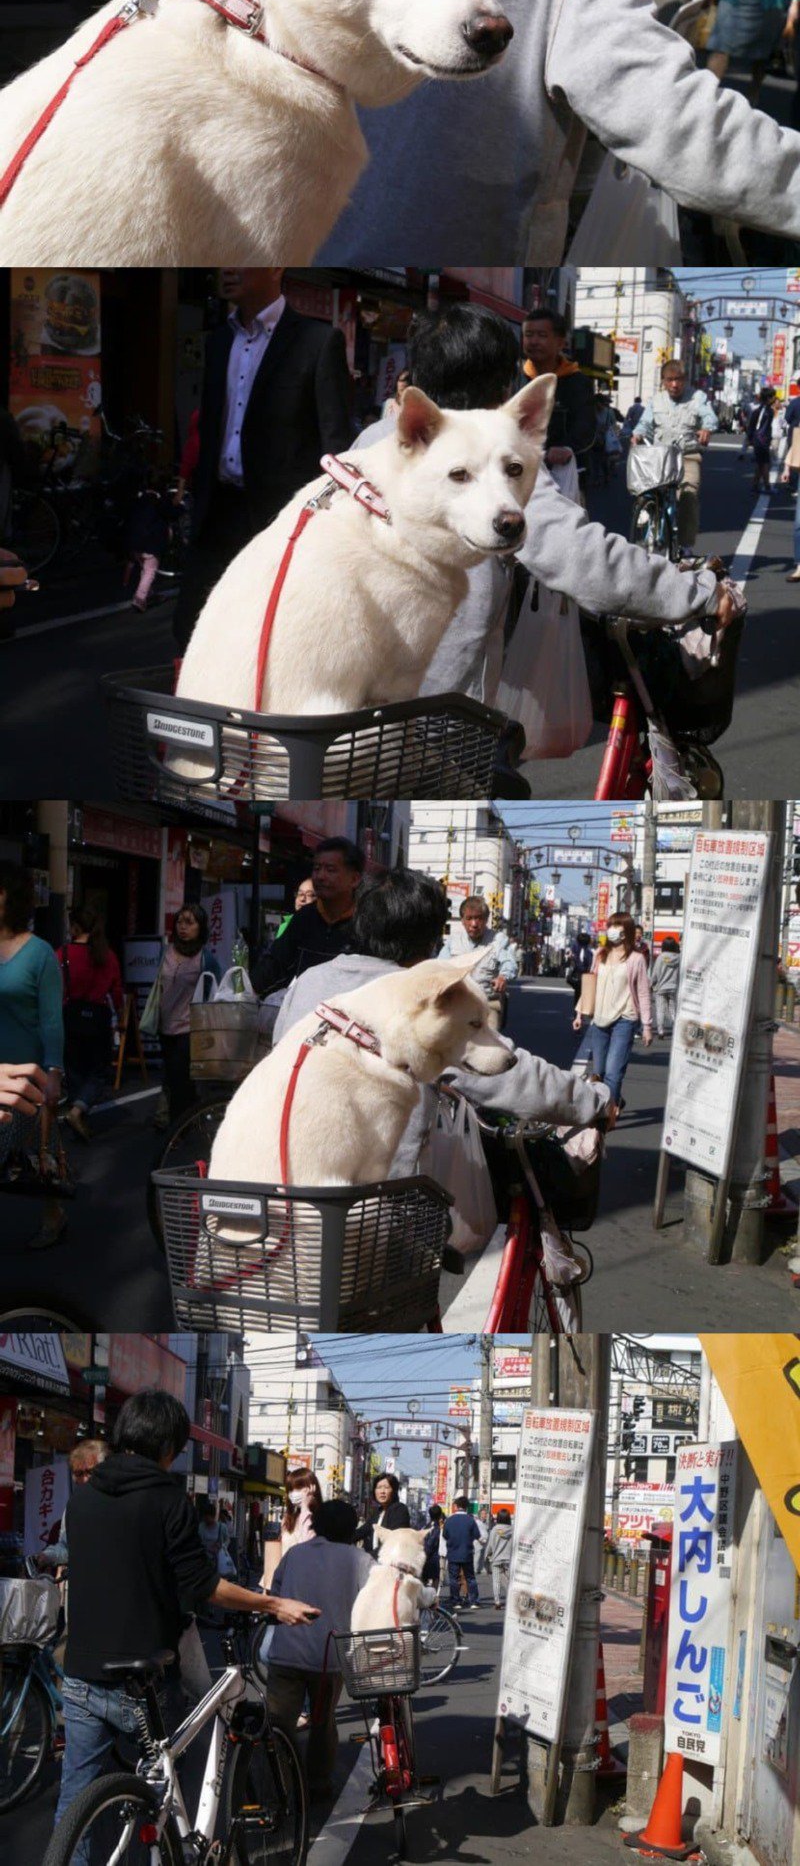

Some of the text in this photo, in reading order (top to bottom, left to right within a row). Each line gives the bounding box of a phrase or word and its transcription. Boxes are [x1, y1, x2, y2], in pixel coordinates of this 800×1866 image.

[154, 718, 207, 740] BRIDGESTONE
[695, 838, 766, 856] 自転車放置規制区域
[208, 1198, 255, 1211] BRIDGESTONE
[525, 1416, 591, 1434] 自転車放置規制区域
[672, 1475, 716, 1725] 大内しんご
[677, 1736, 706, 1753] 自民党
